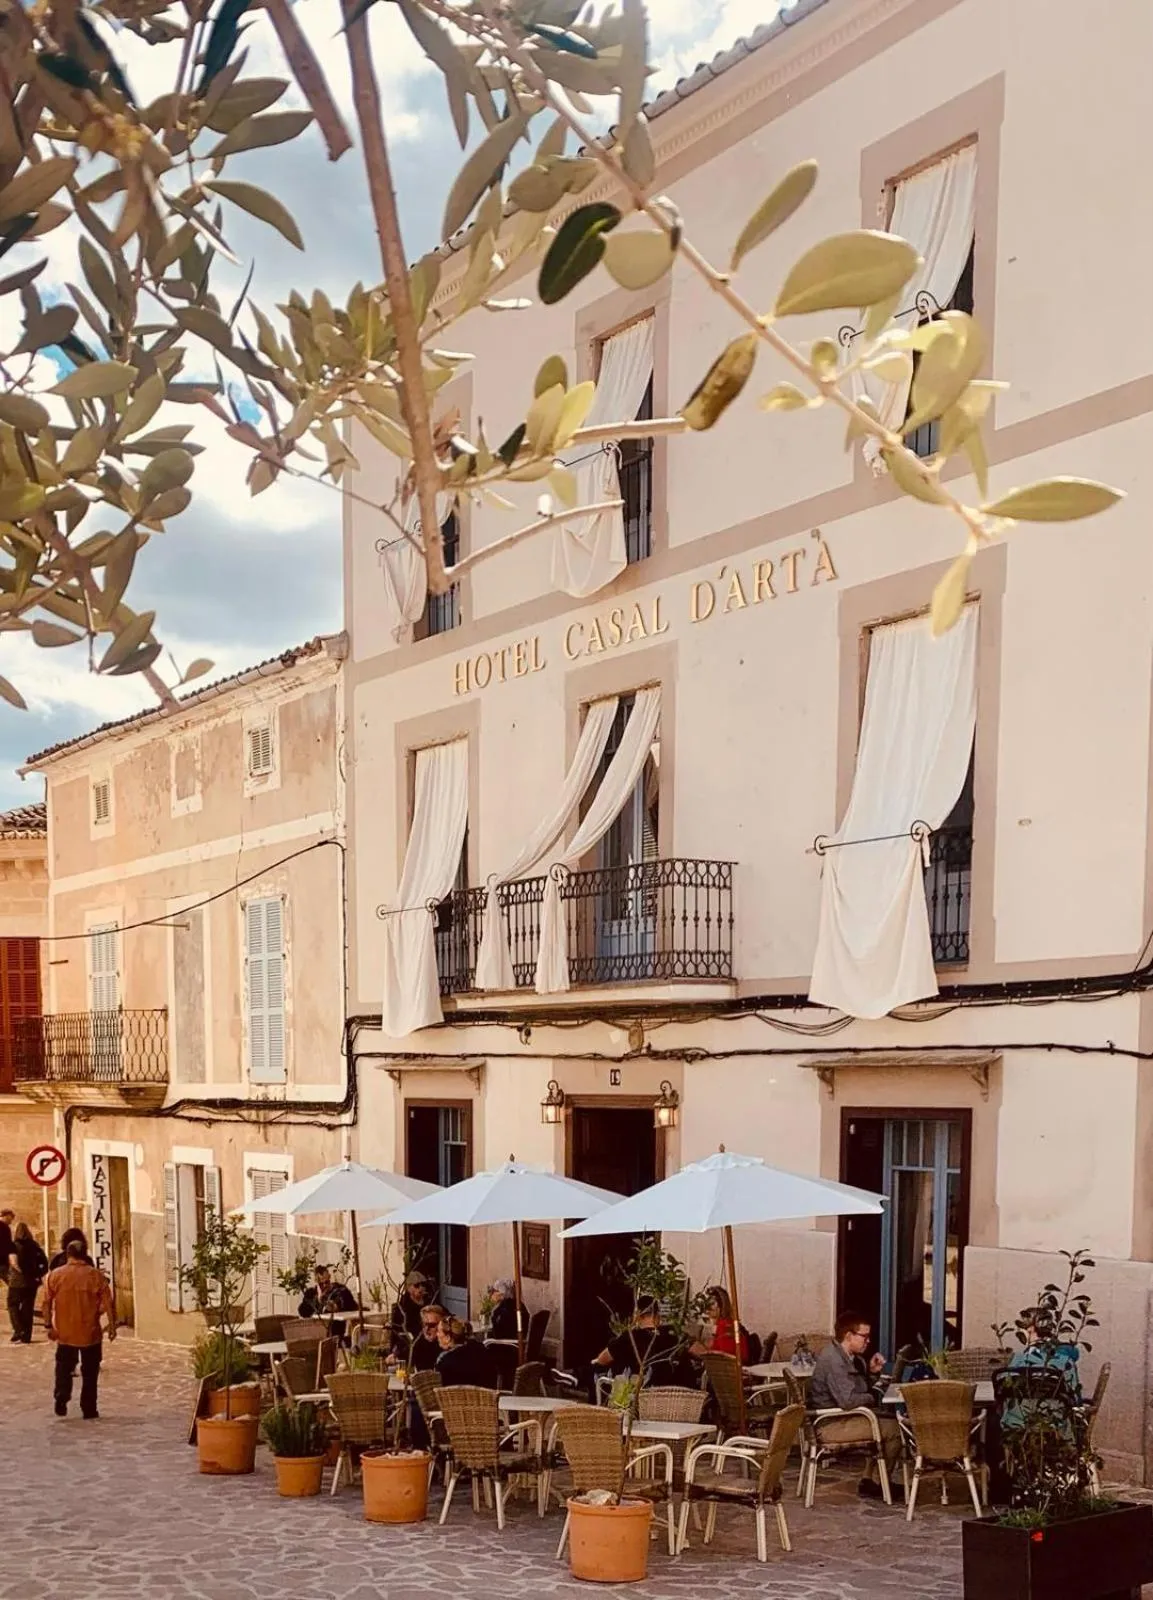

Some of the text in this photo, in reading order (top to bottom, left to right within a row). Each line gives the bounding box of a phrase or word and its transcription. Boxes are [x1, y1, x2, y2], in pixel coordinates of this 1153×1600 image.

[453, 637, 546, 696] HOTEL
[564, 596, 670, 660] CASAL
[92, 1154, 107, 1223] PASTA
